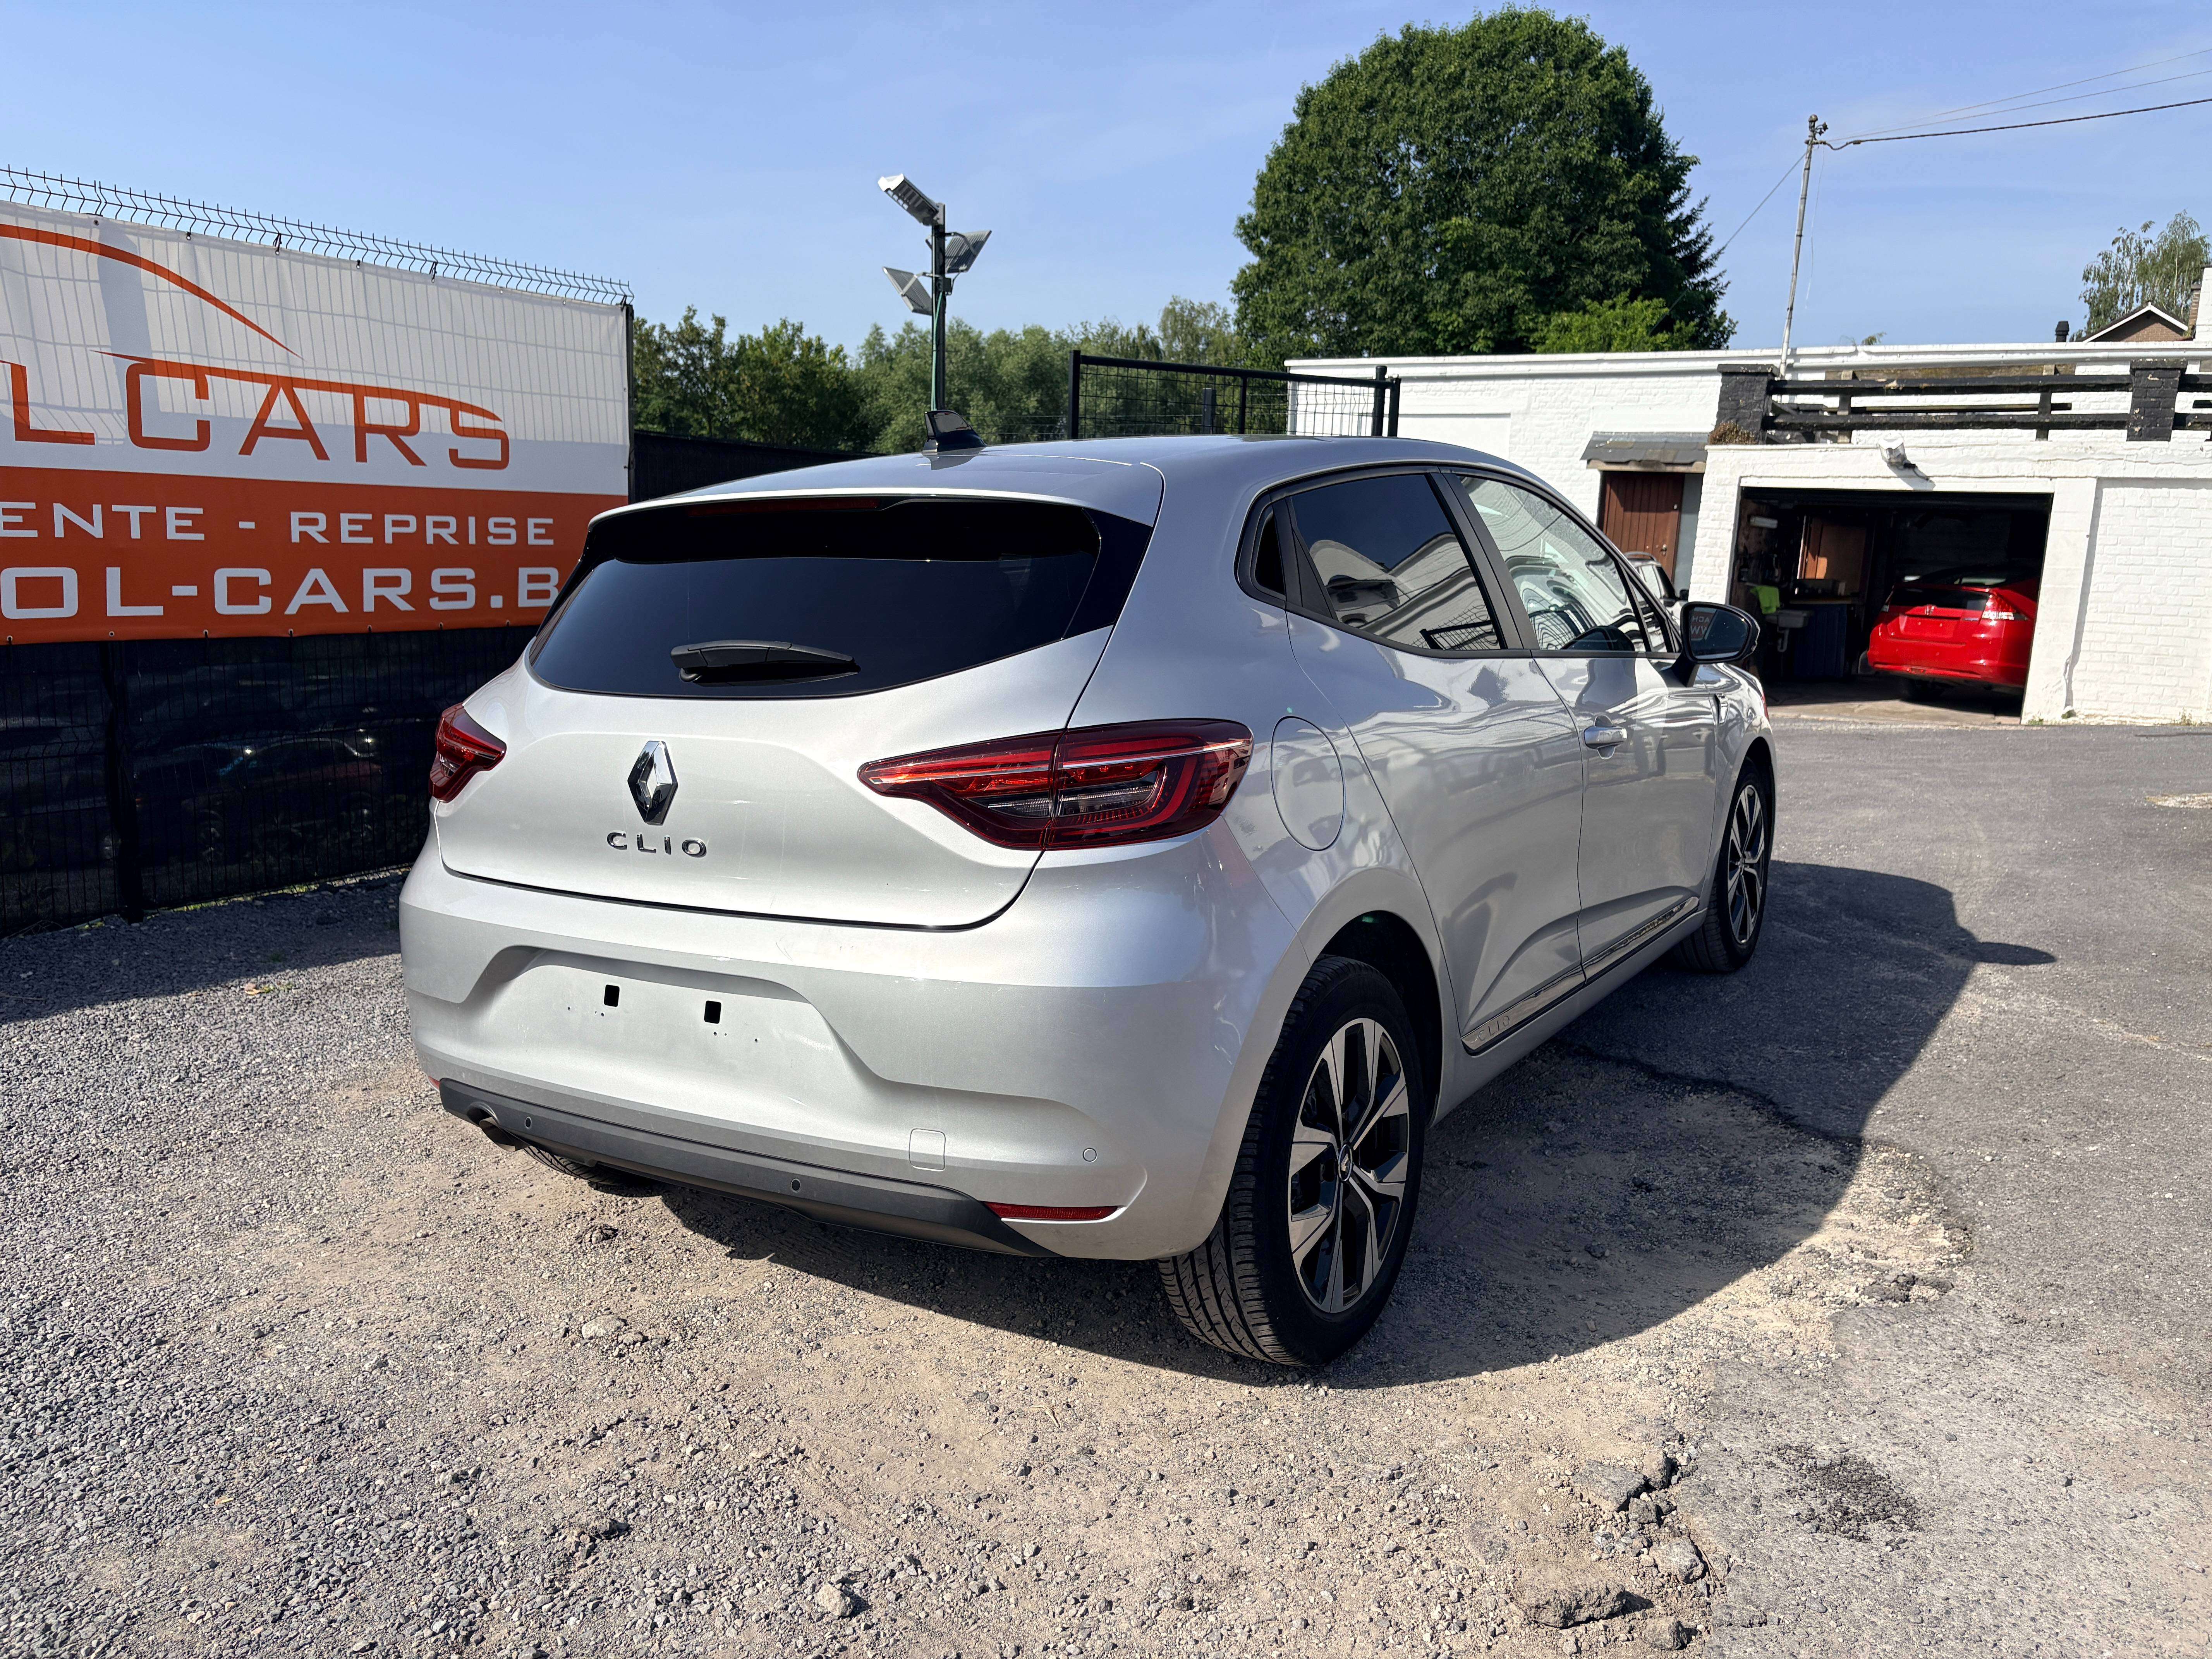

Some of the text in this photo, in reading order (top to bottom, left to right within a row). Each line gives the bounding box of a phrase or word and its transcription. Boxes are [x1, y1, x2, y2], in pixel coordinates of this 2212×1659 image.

[0, 501, 204, 540] ENTE
[291, 512, 555, 546] REPRISE
[607, 832, 707, 857] CLIO
[1479, 1015, 1510, 1041] CLIO
